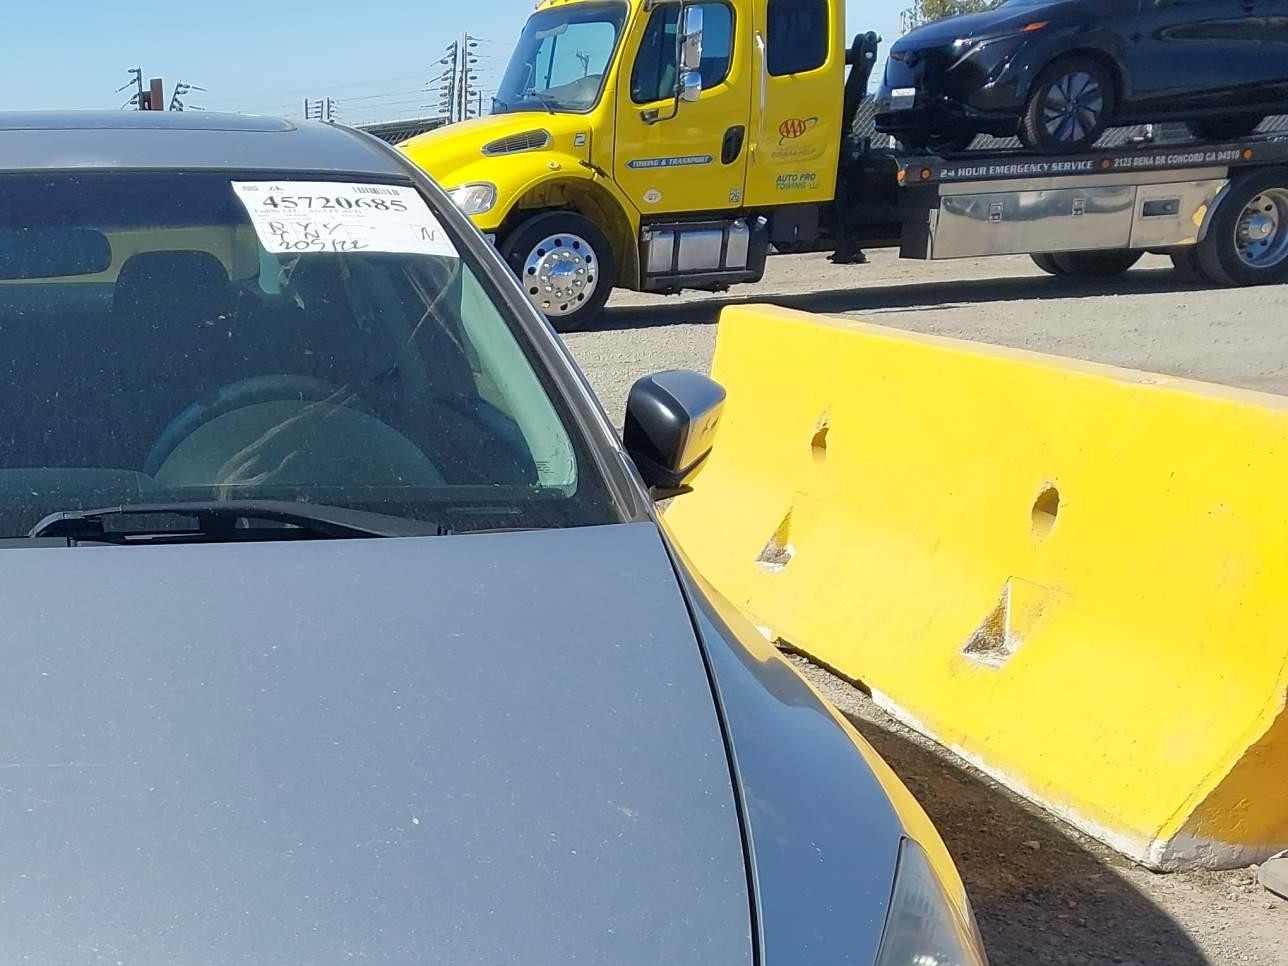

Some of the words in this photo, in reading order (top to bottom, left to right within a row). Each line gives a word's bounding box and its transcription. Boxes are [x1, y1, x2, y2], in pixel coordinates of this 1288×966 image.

[780, 119, 805, 138] AAA
[668, 156, 710, 165] TRANSPORT
[1167, 152, 1203, 164] CONCORD
[1205, 151, 1216, 161] CA
[939, 169, 955, 178] 24
[958, 166, 987, 177] HOUR
[989, 163, 1050, 175] EMERGENCY
[1051, 160, 1093, 171] SERVICE
[776, 174, 798, 183] AUTO
[799, 173, 816, 182] PRO
[262, 195, 408, 212] 45720685
